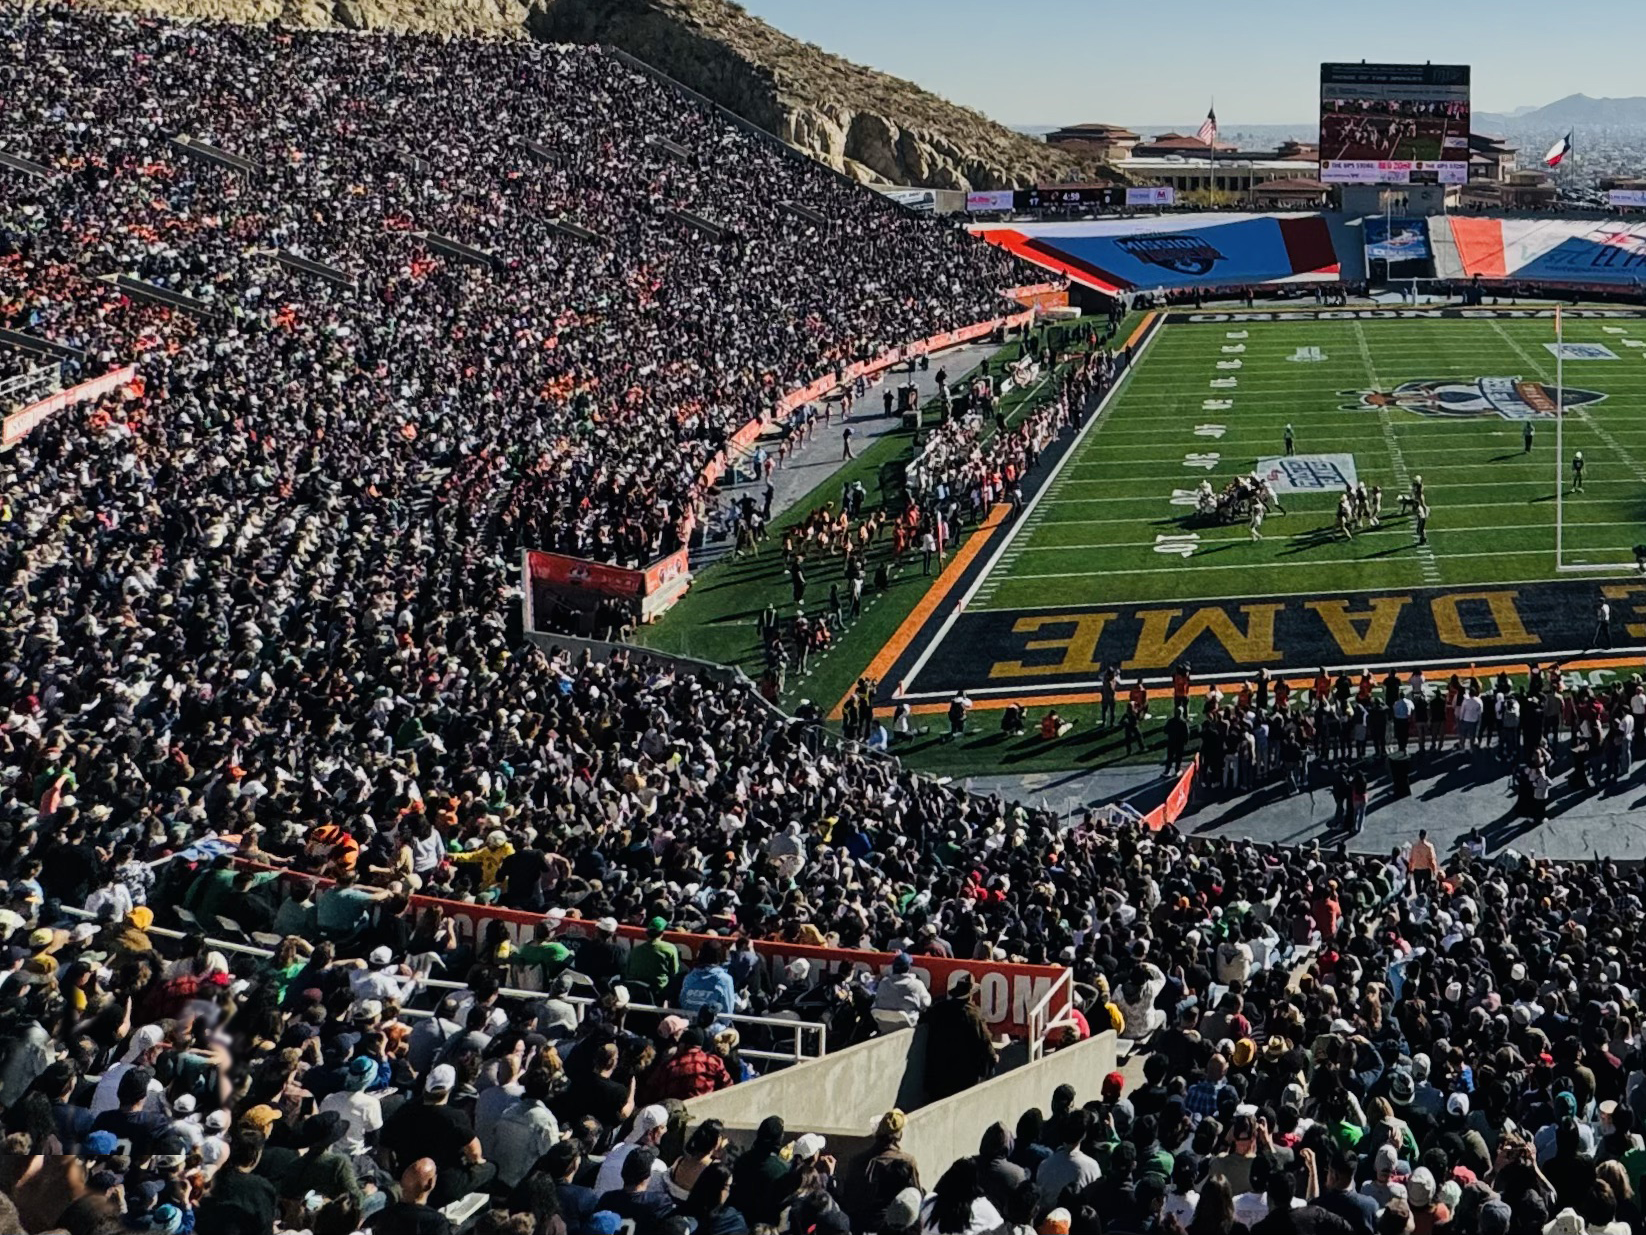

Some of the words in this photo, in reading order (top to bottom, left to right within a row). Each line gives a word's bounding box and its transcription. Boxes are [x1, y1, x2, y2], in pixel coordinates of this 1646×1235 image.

[1117, 237, 1207, 252] MISSION
[1589, 246, 1619, 267] EL
[1188, 310, 1442, 322] OREGON
[1460, 310, 1641, 318] STATE
[1153, 533, 1200, 552] 10
[988, 589, 1542, 678] DAME
